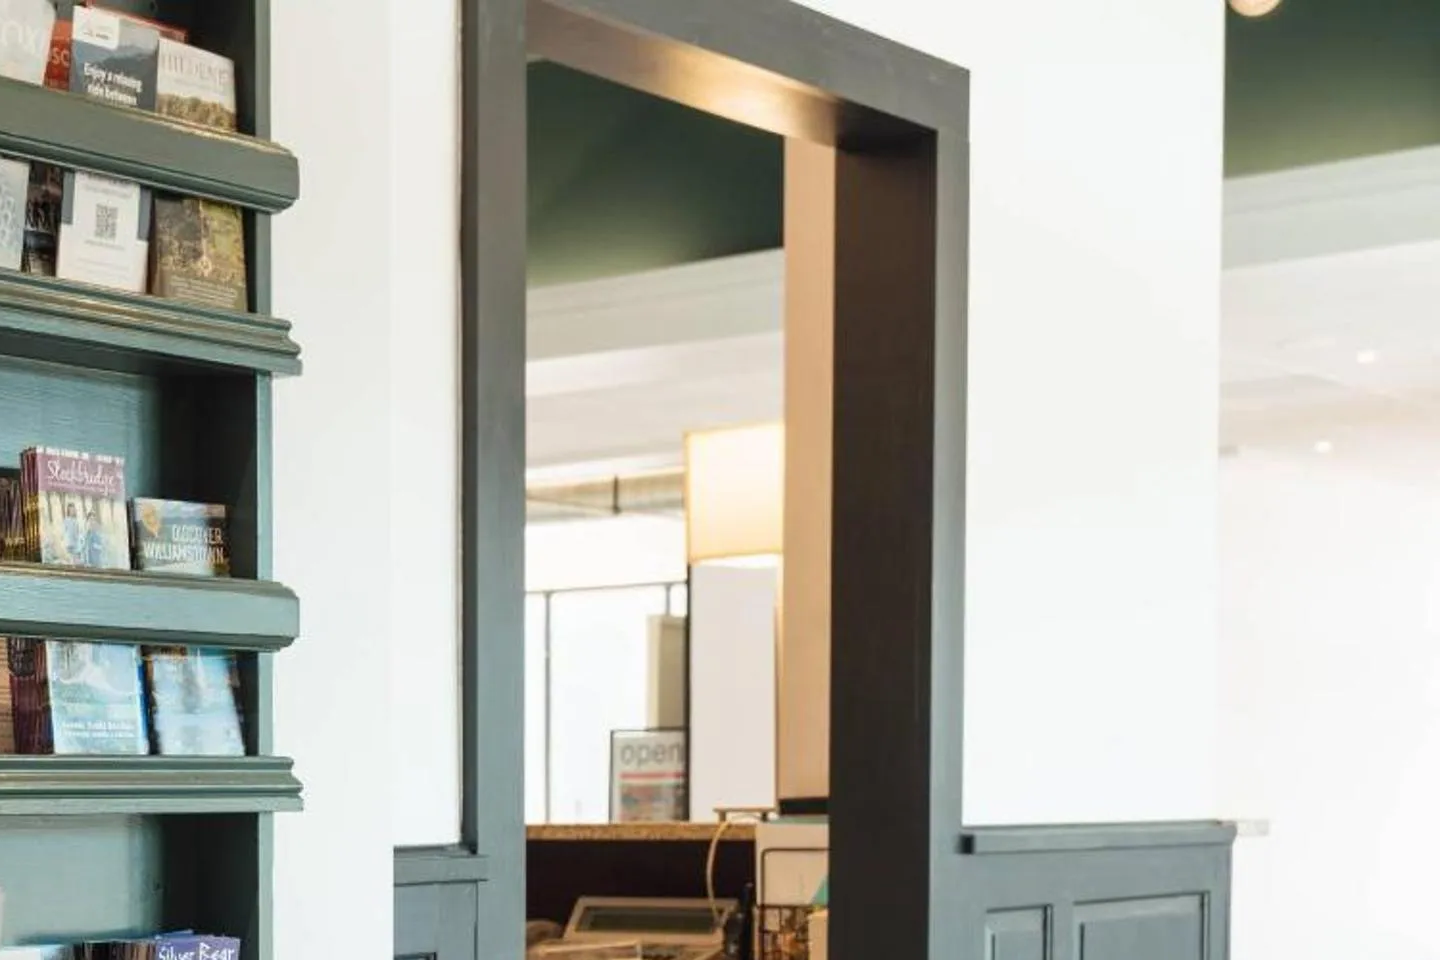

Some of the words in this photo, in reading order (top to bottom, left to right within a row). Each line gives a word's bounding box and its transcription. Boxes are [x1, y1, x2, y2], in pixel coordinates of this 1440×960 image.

[172, 523, 222, 545] DISCOVER
[144, 540, 225, 564] WILLIAMSTOWN
[619, 741, 685, 768] open
